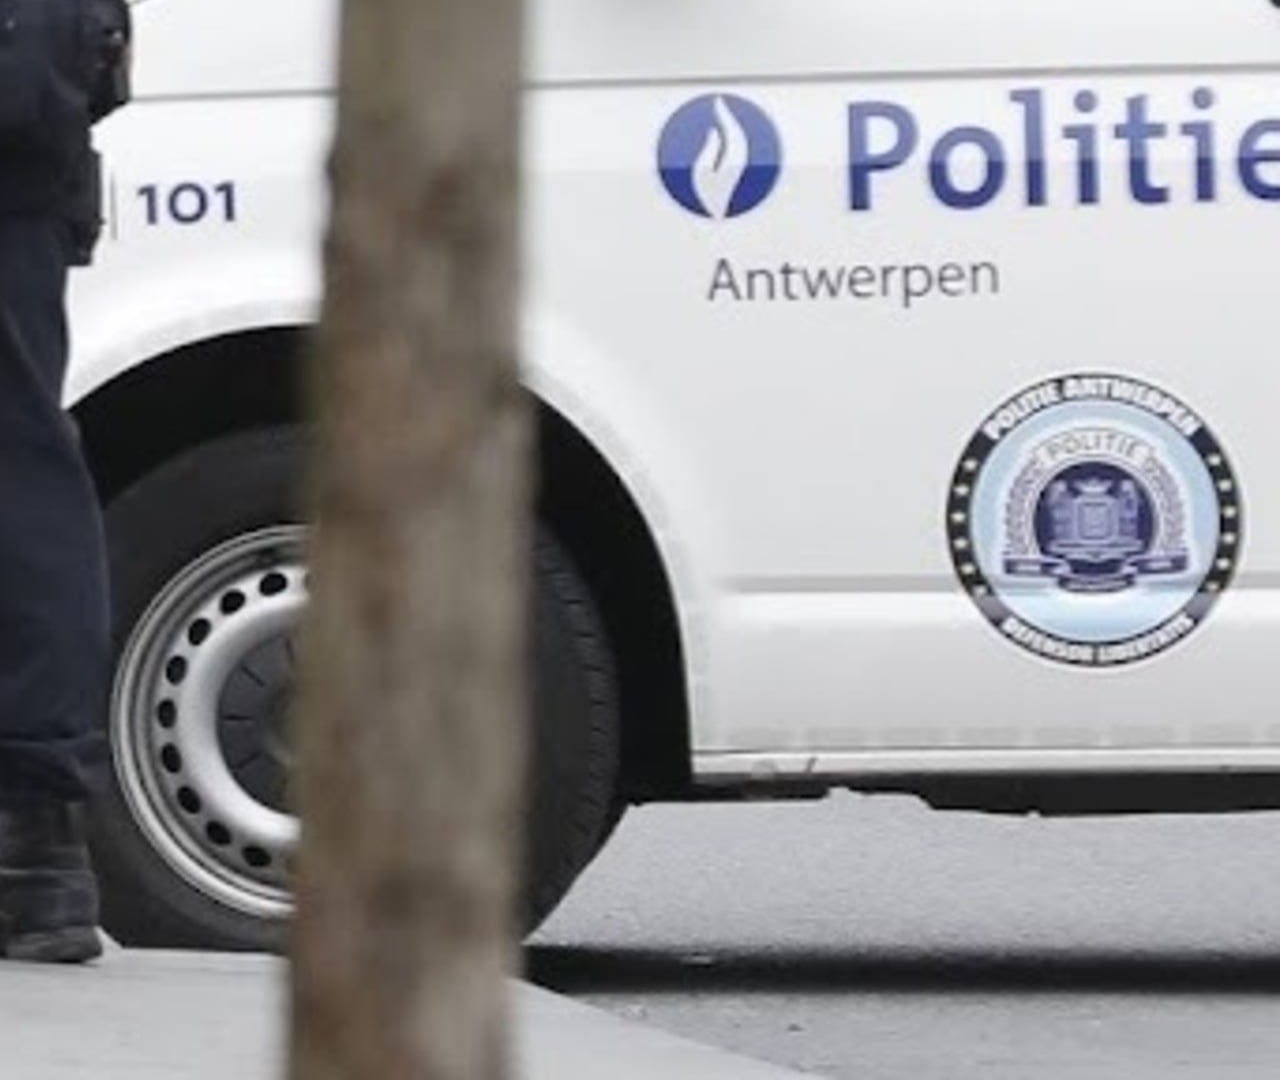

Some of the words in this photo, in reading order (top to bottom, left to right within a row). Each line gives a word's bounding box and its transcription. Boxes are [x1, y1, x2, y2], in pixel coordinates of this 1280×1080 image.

[846, 85, 1280, 212] Politie
[137, 180, 236, 226] 101
[706, 257, 1001, 309] Antwerpen
[981, 379, 1062, 438] POLITIE
